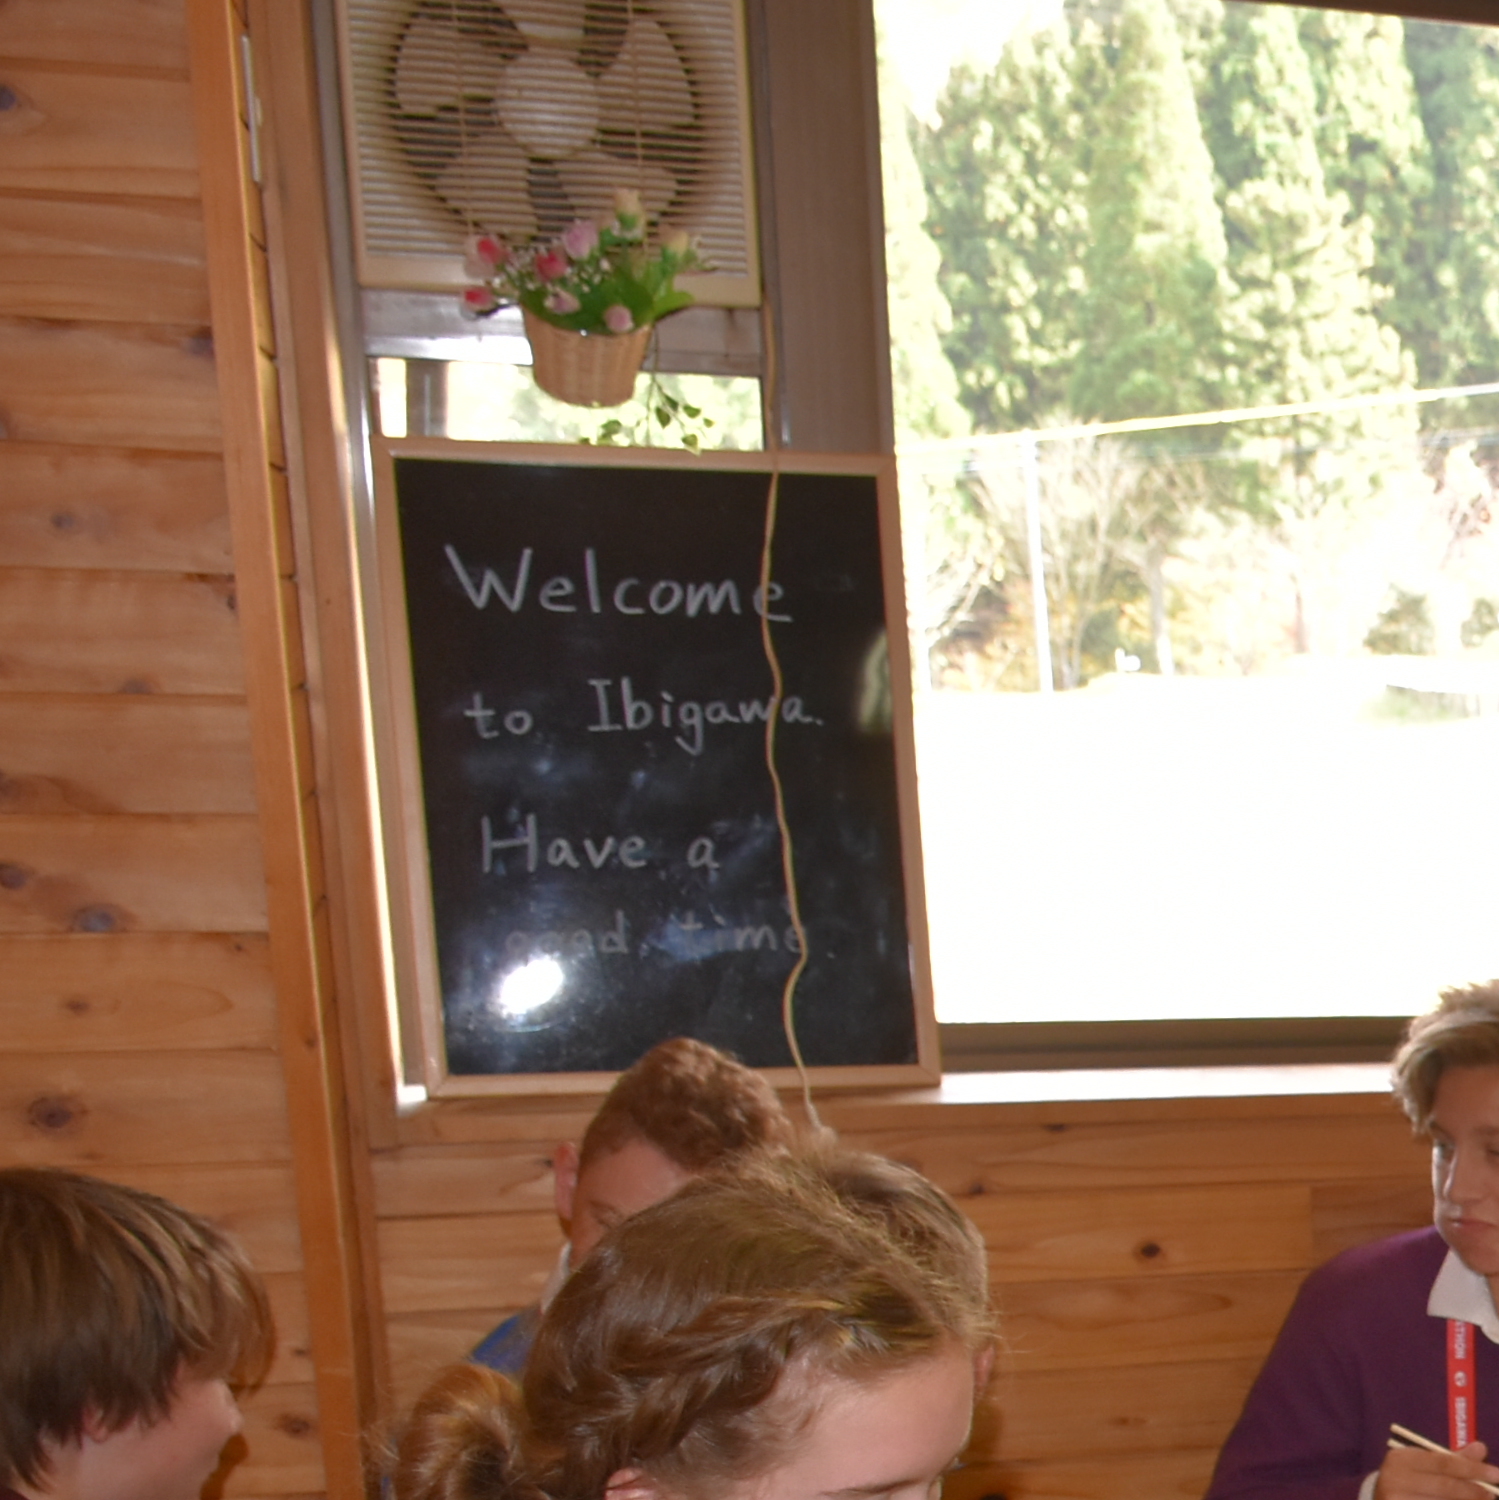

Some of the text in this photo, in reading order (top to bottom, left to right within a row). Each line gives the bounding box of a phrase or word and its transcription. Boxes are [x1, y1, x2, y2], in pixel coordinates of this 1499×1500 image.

[445, 545, 793, 622] Welcome
[464, 692, 532, 738] to
[481, 813, 720, 873] Have a
